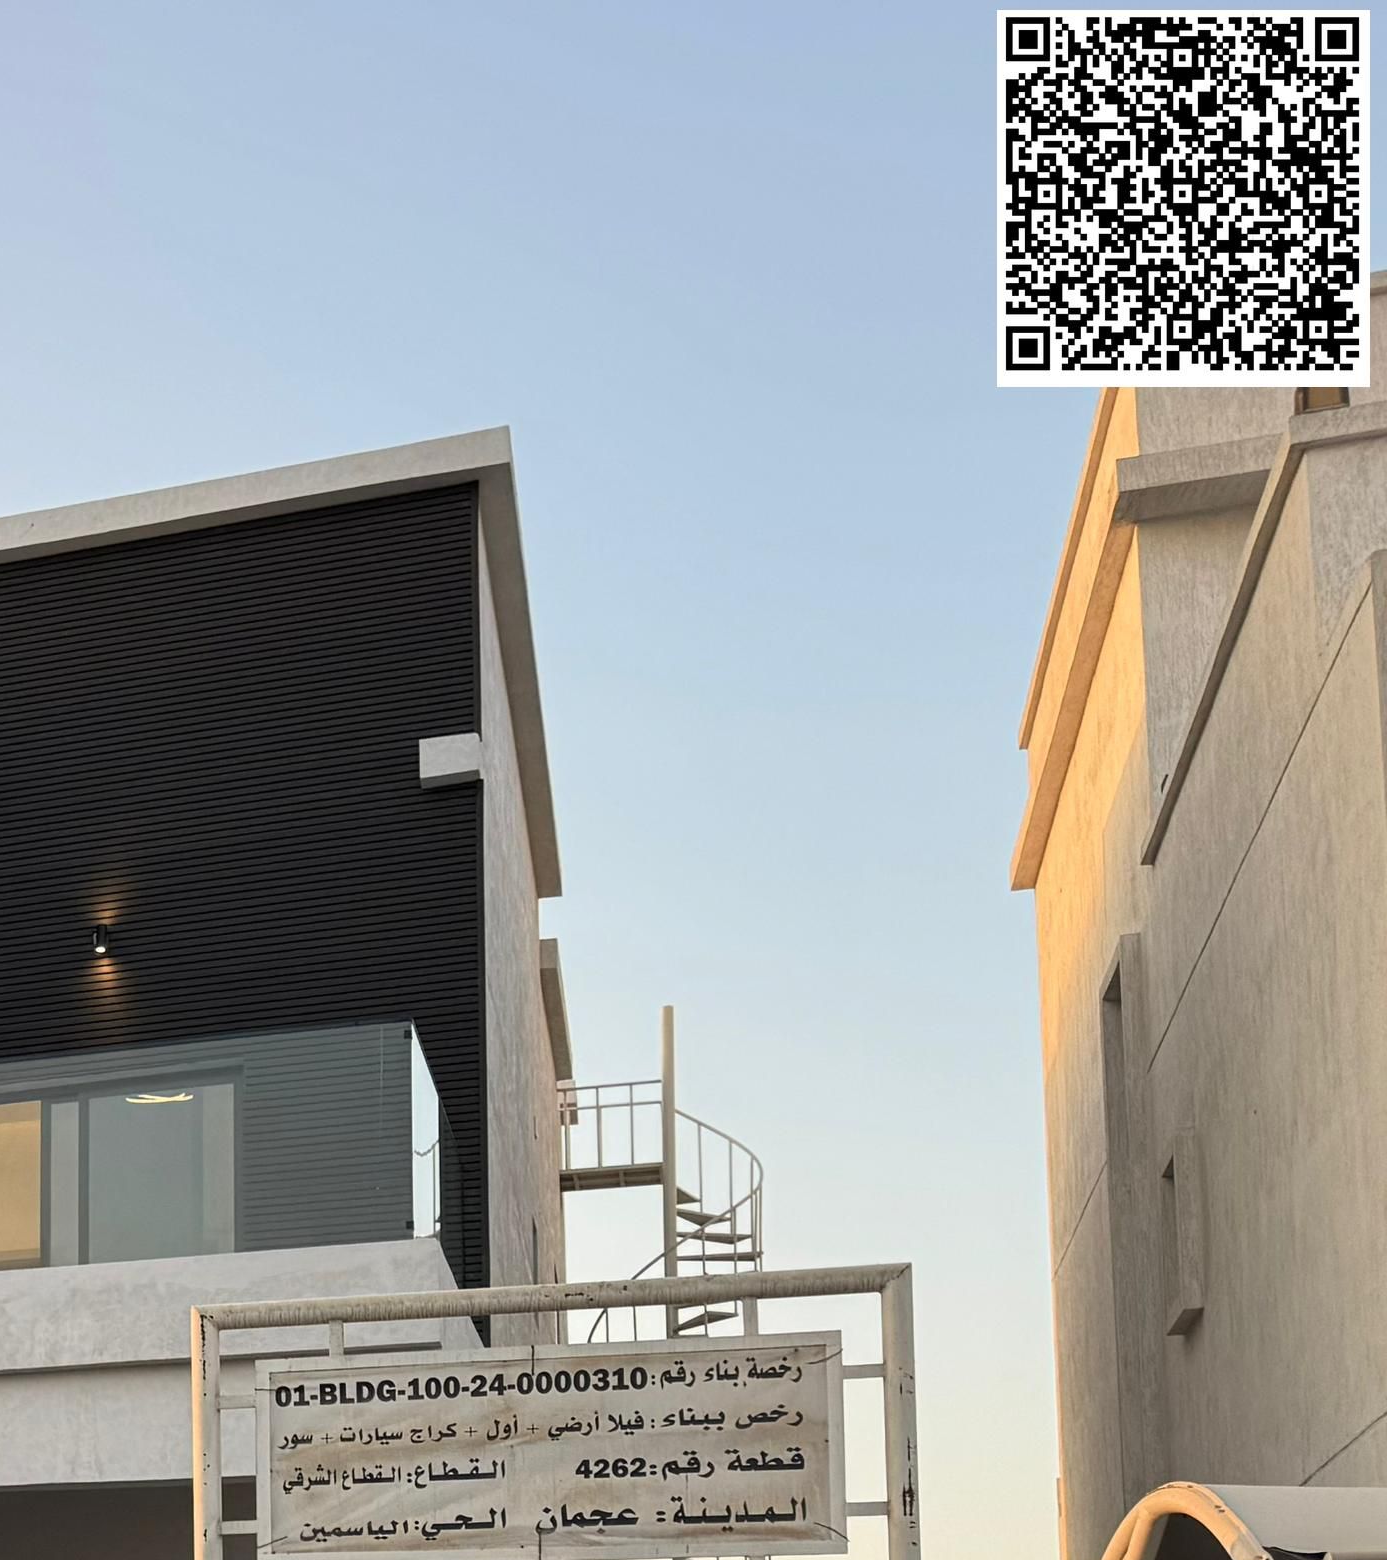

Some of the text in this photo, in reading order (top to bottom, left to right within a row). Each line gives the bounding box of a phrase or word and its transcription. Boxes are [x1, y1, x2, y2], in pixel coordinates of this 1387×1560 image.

[702, 1359, 740, 1388] بناء
[745, 1356, 803, 1383] رخصة
[274, 1366, 648, 1408] 01-BLDG-100-24-0000310
[486, 1414, 519, 1441] أول
[547, 1410, 601, 1441] أرضي
[607, 1409, 645, 1436] فيلا
[734, 1403, 804, 1430] رخص
[277, 1432, 314, 1450] سور
[339, 1426, 403, 1446] سيارات
[409, 1422, 458, 1445] كراج
[574, 1457, 648, 1479] 4262
[725, 1446, 806, 1472] قطعة
[282, 1463, 338, 1494] الشرقي
[340, 1464, 402, 1490] القطاع
[299, 1518, 409, 1543] الياسمين
[534, 1503, 640, 1535] عجمان
